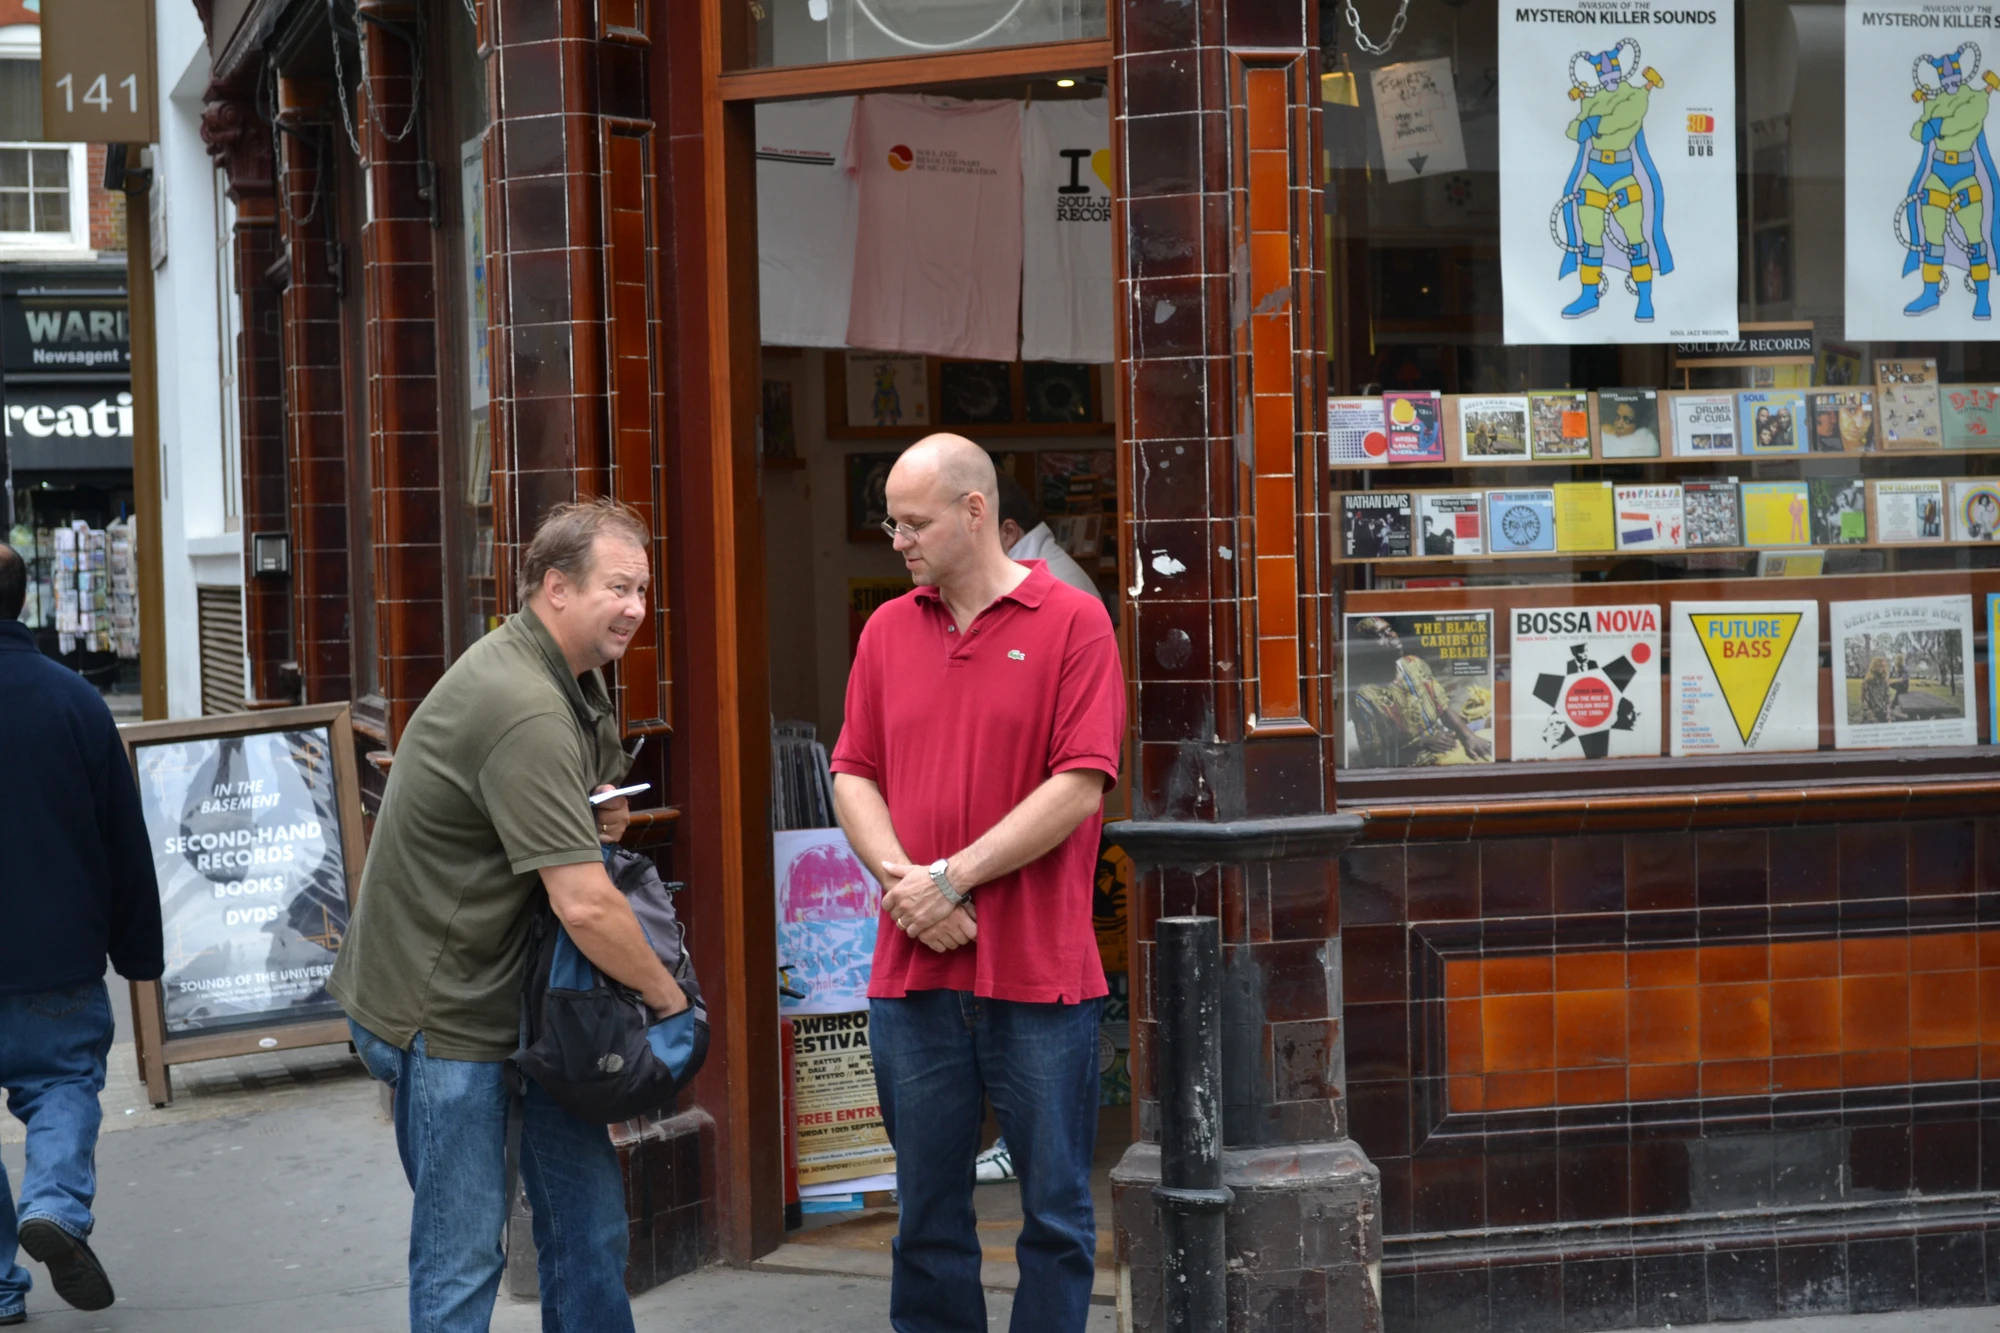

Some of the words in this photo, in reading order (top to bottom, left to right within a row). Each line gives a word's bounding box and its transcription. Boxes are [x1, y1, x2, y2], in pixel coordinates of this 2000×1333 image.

[1578, 1, 1618, 10] INVASION
[1620, 1, 1632, 10] OF
[1634, 2, 1650, 10] THE
[1922, 5, 1961, 13] INVASION
[1963, 5, 1975, 13] OF
[1516, 8, 1596, 24] MYSTERON
[1600, 10, 1650, 24] KILLER
[1653, 10, 1716, 24] SOUNDS
[1862, 11, 1940, 28] MYSTERON
[1943, 14, 1992, 28] KILLER
[56, 72, 139, 113] 141
[1688, 146, 1713, 156] DUB
[1058, 149, 1092, 194] I
[1057, 196, 1095, 208] SOUL
[1678, 342, 1713, 352] SOUL
[1715, 340, 1747, 352] JAZZ
[1749, 337, 1811, 352] RECORDS
[33, 348, 119, 366] Newsagent
[1880, 364, 1903, 373] DUB
[1880, 373, 1924, 384] ECHOES
[1743, 394, 1767, 402] SOUL
[4, 391, 133, 438] reati
[1695, 405, 1731, 414] DRUMS
[1689, 415, 1702, 423] OF
[1704, 414, 1731, 423] CUBA
[1345, 495, 1382, 509] NATHAN
[1383, 494, 1409, 508] DAVIS
[854, 587, 906, 610] STUD
[1884, 606, 1929, 618] SWAMP
[1414, 622, 1442, 635] THE
[1446, 621, 1486, 634] BLACK
[1517, 611, 1592, 635] BOSSA
[1596, 610, 1656, 632] NOVA
[1708, 619, 1781, 639] FUTURE
[1421, 634, 1469, 647] CARIBS
[1471, 633, 1487, 645] OF
[1440, 646, 1488, 659] BELIZE
[1723, 640, 1772, 659] BASS
[1748, 731, 1761, 748] SOUL
[1757, 713, 1769, 730] JAZZ
[1764, 682, 1782, 712] RECORDS
[214, 782, 232, 798] IN
[236, 779, 265, 795] THE
[201, 792, 281, 814] BASEMENT
[164, 821, 322, 854] SECOND-HAND
[197, 844, 295, 870] RECORDS
[214, 875, 284, 898] BOOKS
[226, 905, 278, 926] DVDS
[179, 977, 232, 993] SOUNDS
[235, 974, 251, 986] OF
[254, 971, 277, 984] THE
[795, 1031, 868, 1054] ESTIVA
[814, 1057, 842, 1066] RATTUS
[815, 1072, 845, 1080] MYSTRO
[797, 1111, 833, 1127] FREE
[831, 1125, 849, 1134] 10th
